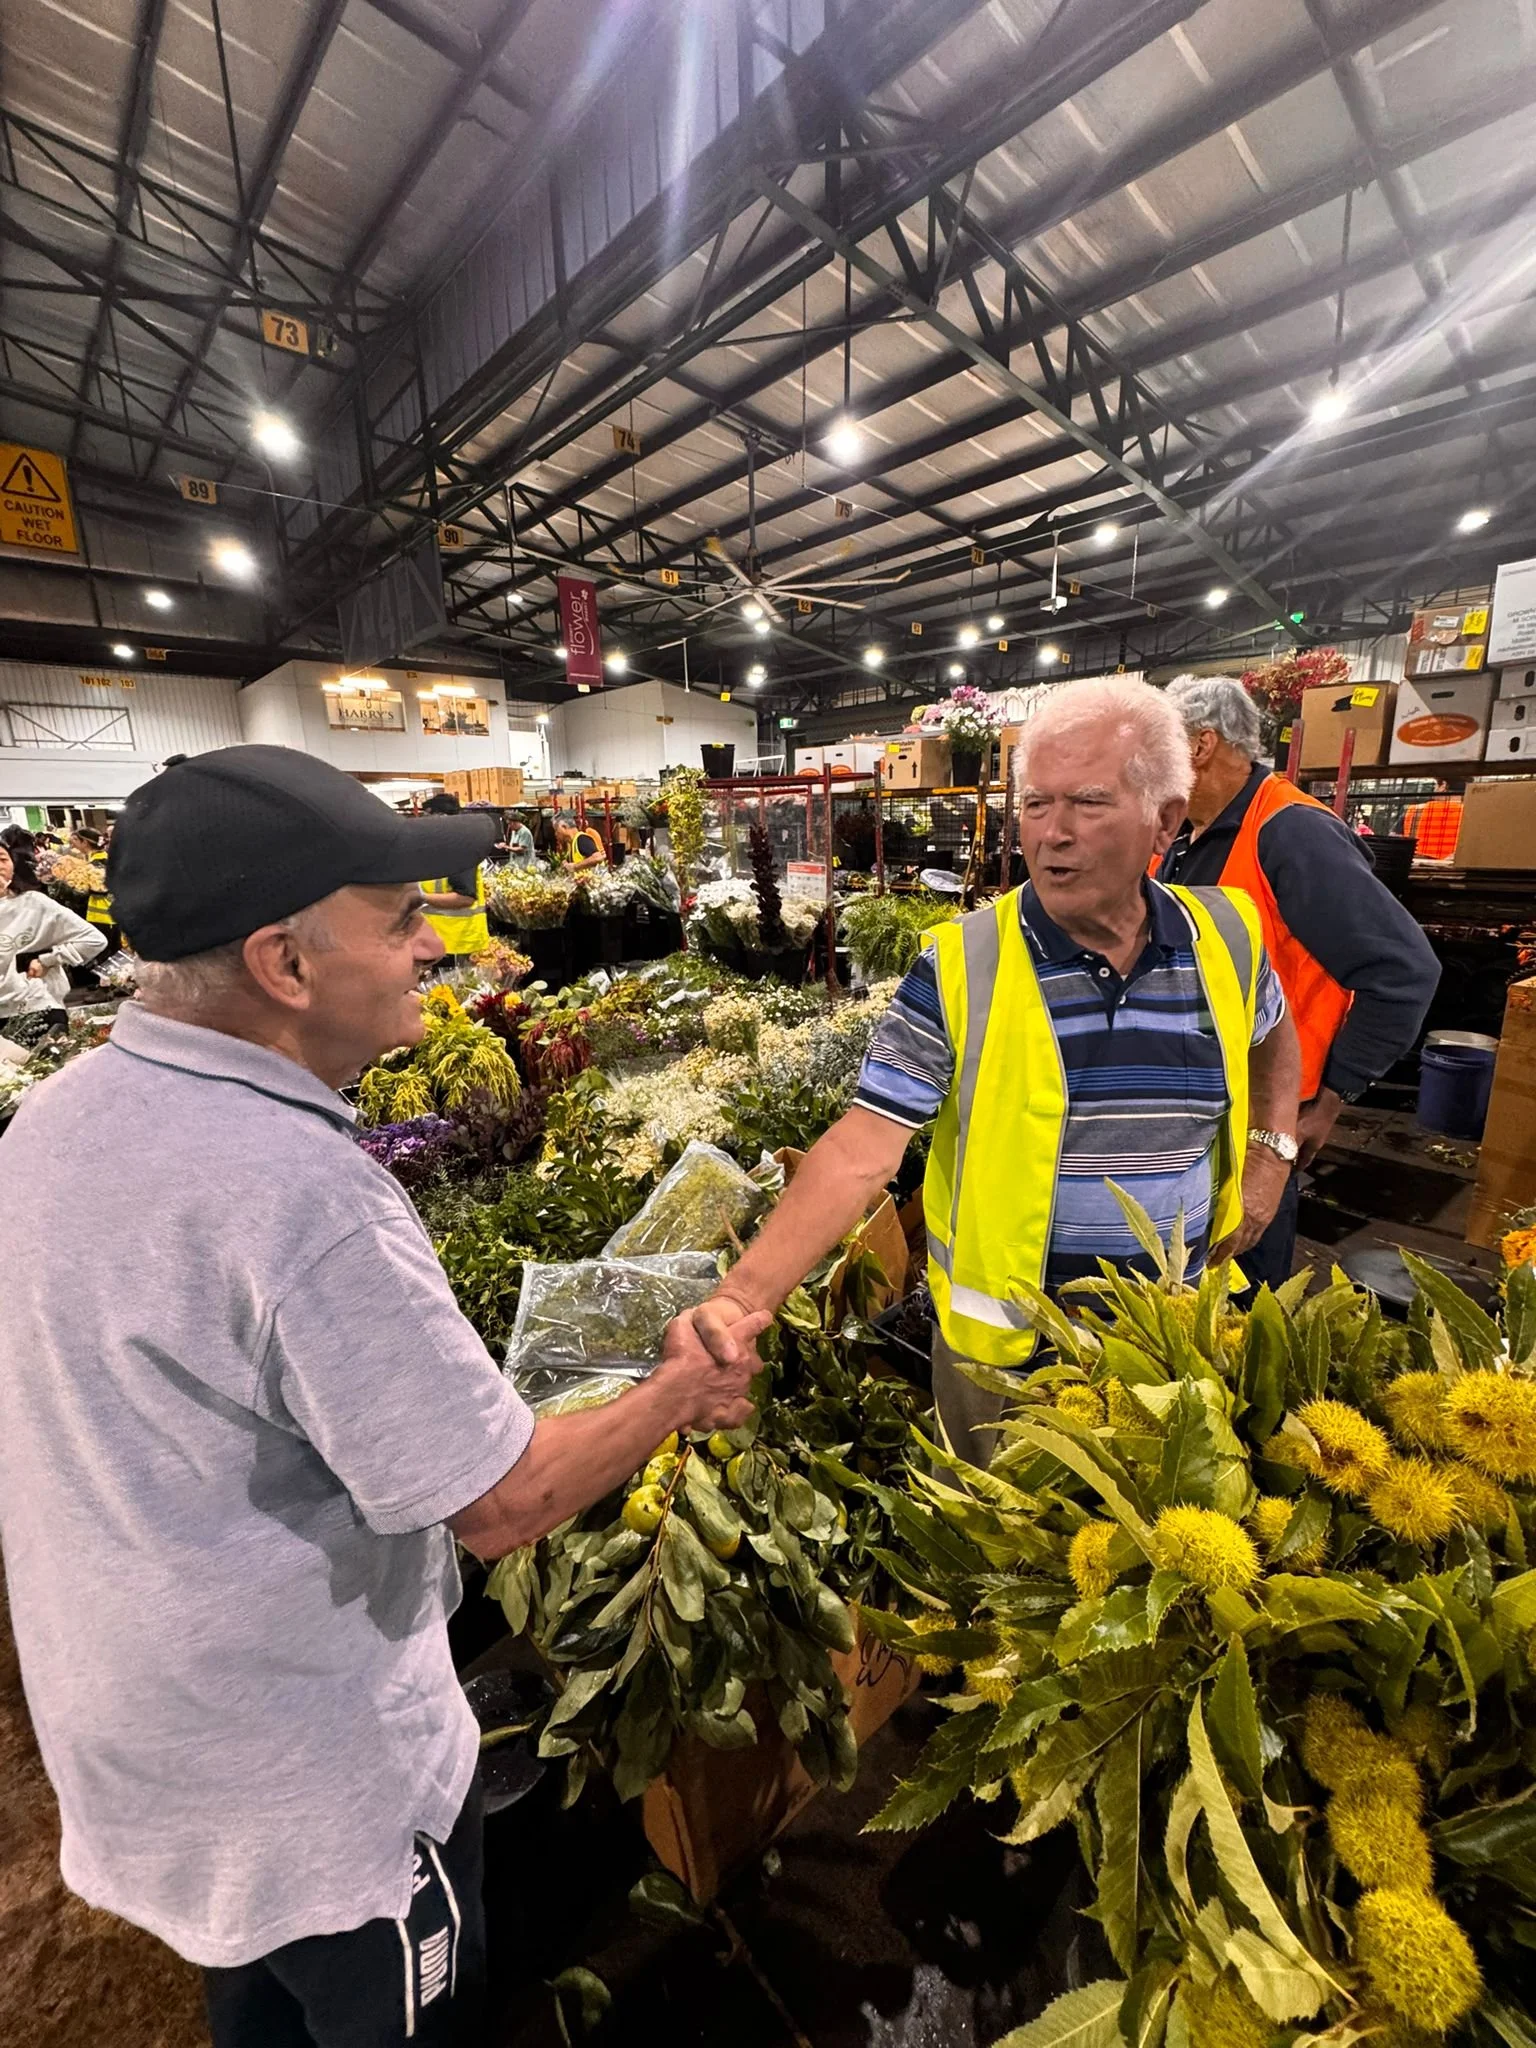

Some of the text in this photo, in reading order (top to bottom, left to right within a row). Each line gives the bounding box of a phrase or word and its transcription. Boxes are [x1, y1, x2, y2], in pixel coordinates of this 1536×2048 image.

[271, 316, 299, 346] 73
[619, 430, 635, 451] 74
[189, 481, 209, 499] 89
[4, 499, 64, 520] CAUTION
[21, 517, 51, 531] WET
[17, 529, 63, 547] FLOOR
[444, 529, 459, 544] 90
[665, 571, 675, 583] 91
[570, 591, 586, 655] flower
[96, 677, 112, 687] 102
[121, 679, 135, 688] 103
[338, 707, 395, 720] HARRY'S
